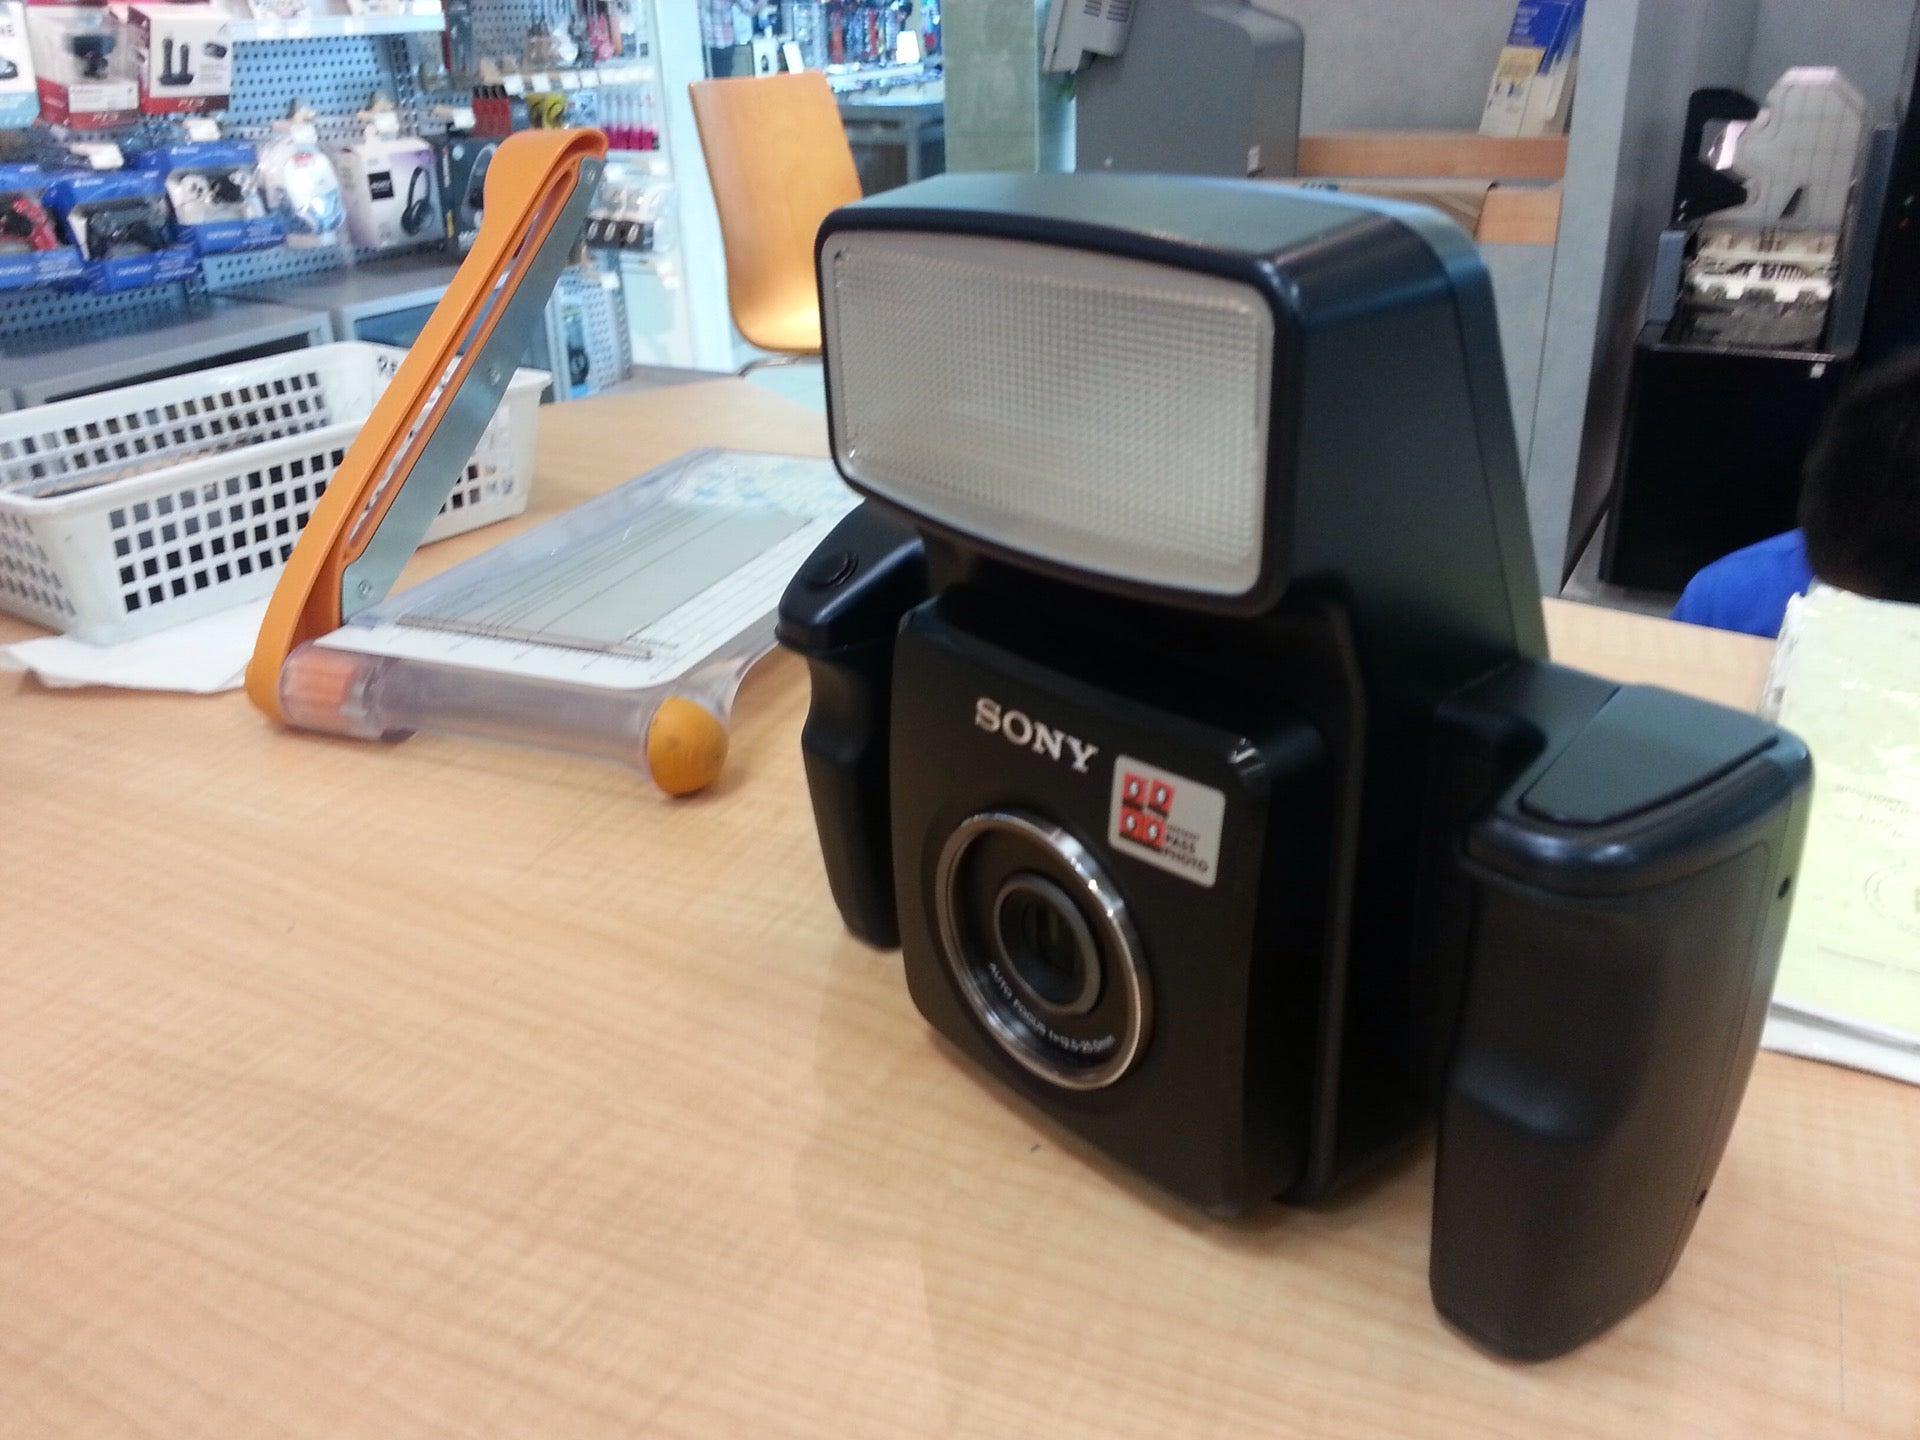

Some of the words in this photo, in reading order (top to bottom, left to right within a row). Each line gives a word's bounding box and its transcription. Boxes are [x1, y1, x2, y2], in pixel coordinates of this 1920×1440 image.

[974, 697, 1099, 774] SONY
[989, 962, 1013, 999] AUTO
[1013, 998, 1047, 1036] FOCUS
